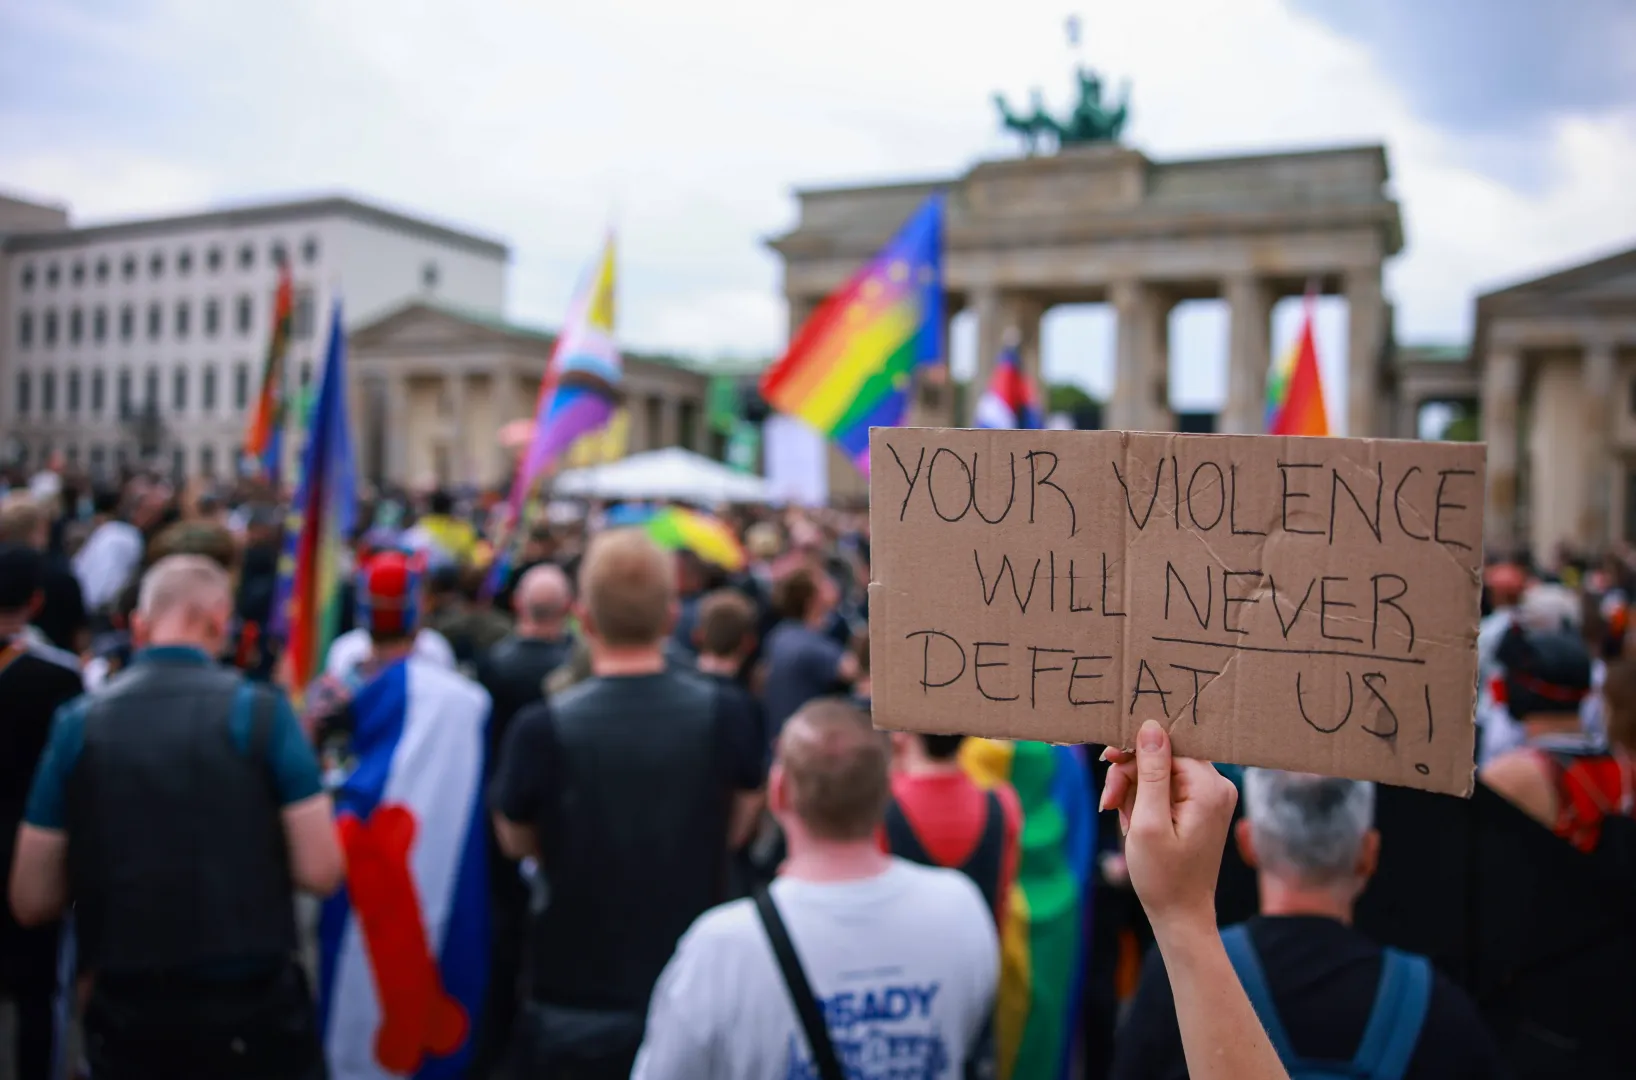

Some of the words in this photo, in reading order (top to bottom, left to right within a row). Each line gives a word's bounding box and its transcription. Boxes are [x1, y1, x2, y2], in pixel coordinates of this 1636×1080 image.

[886, 443, 1076, 537] YOUR
[1112, 456, 1475, 550] VIOLENCE
[974, 549, 1126, 617] WILL
[1164, 560, 1415, 653] NEVER
[905, 630, 1220, 724] DEFEAT
[1296, 671, 1433, 775] US!
